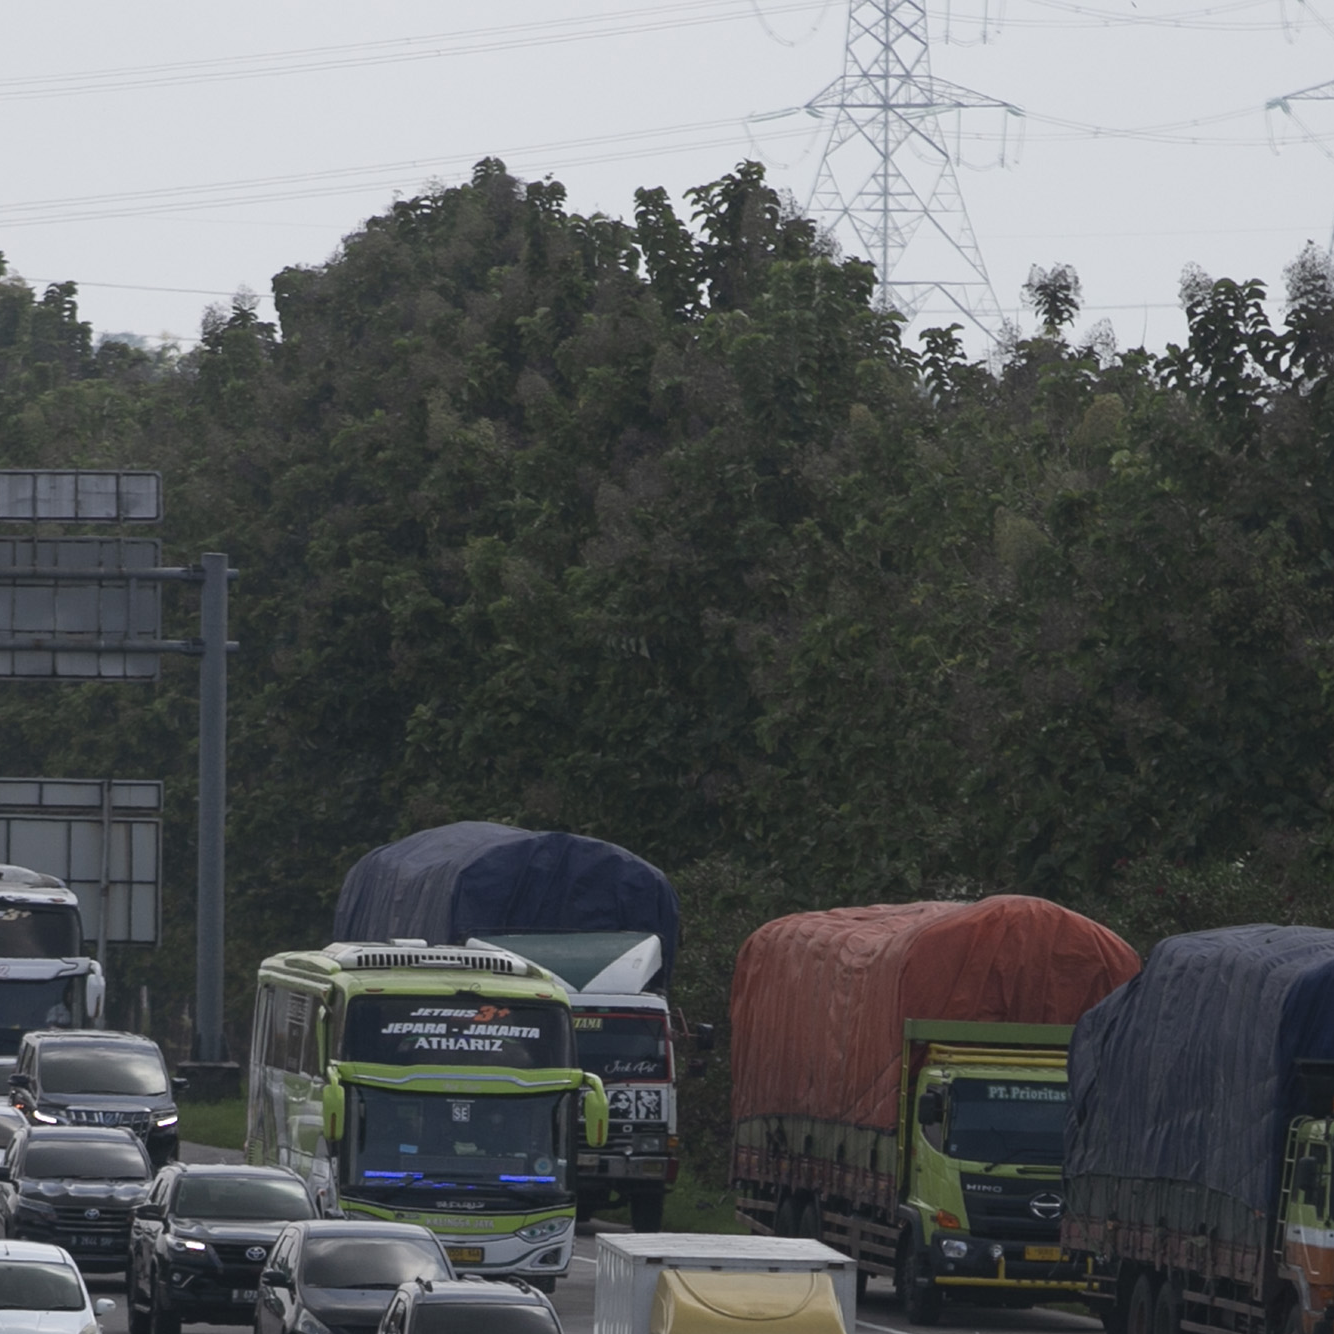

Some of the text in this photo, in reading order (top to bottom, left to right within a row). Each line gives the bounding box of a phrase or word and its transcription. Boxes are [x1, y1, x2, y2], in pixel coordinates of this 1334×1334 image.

[381, 1023, 447, 1035] JEPARA
[463, 1024, 540, 1039] JAKARTA
[414, 1037, 503, 1051] ATHARIZ
[1012, 1086, 1067, 1101] Prioritas
[452, 1105, 469, 1120] SE
[966, 1183, 1002, 1193] HINO
